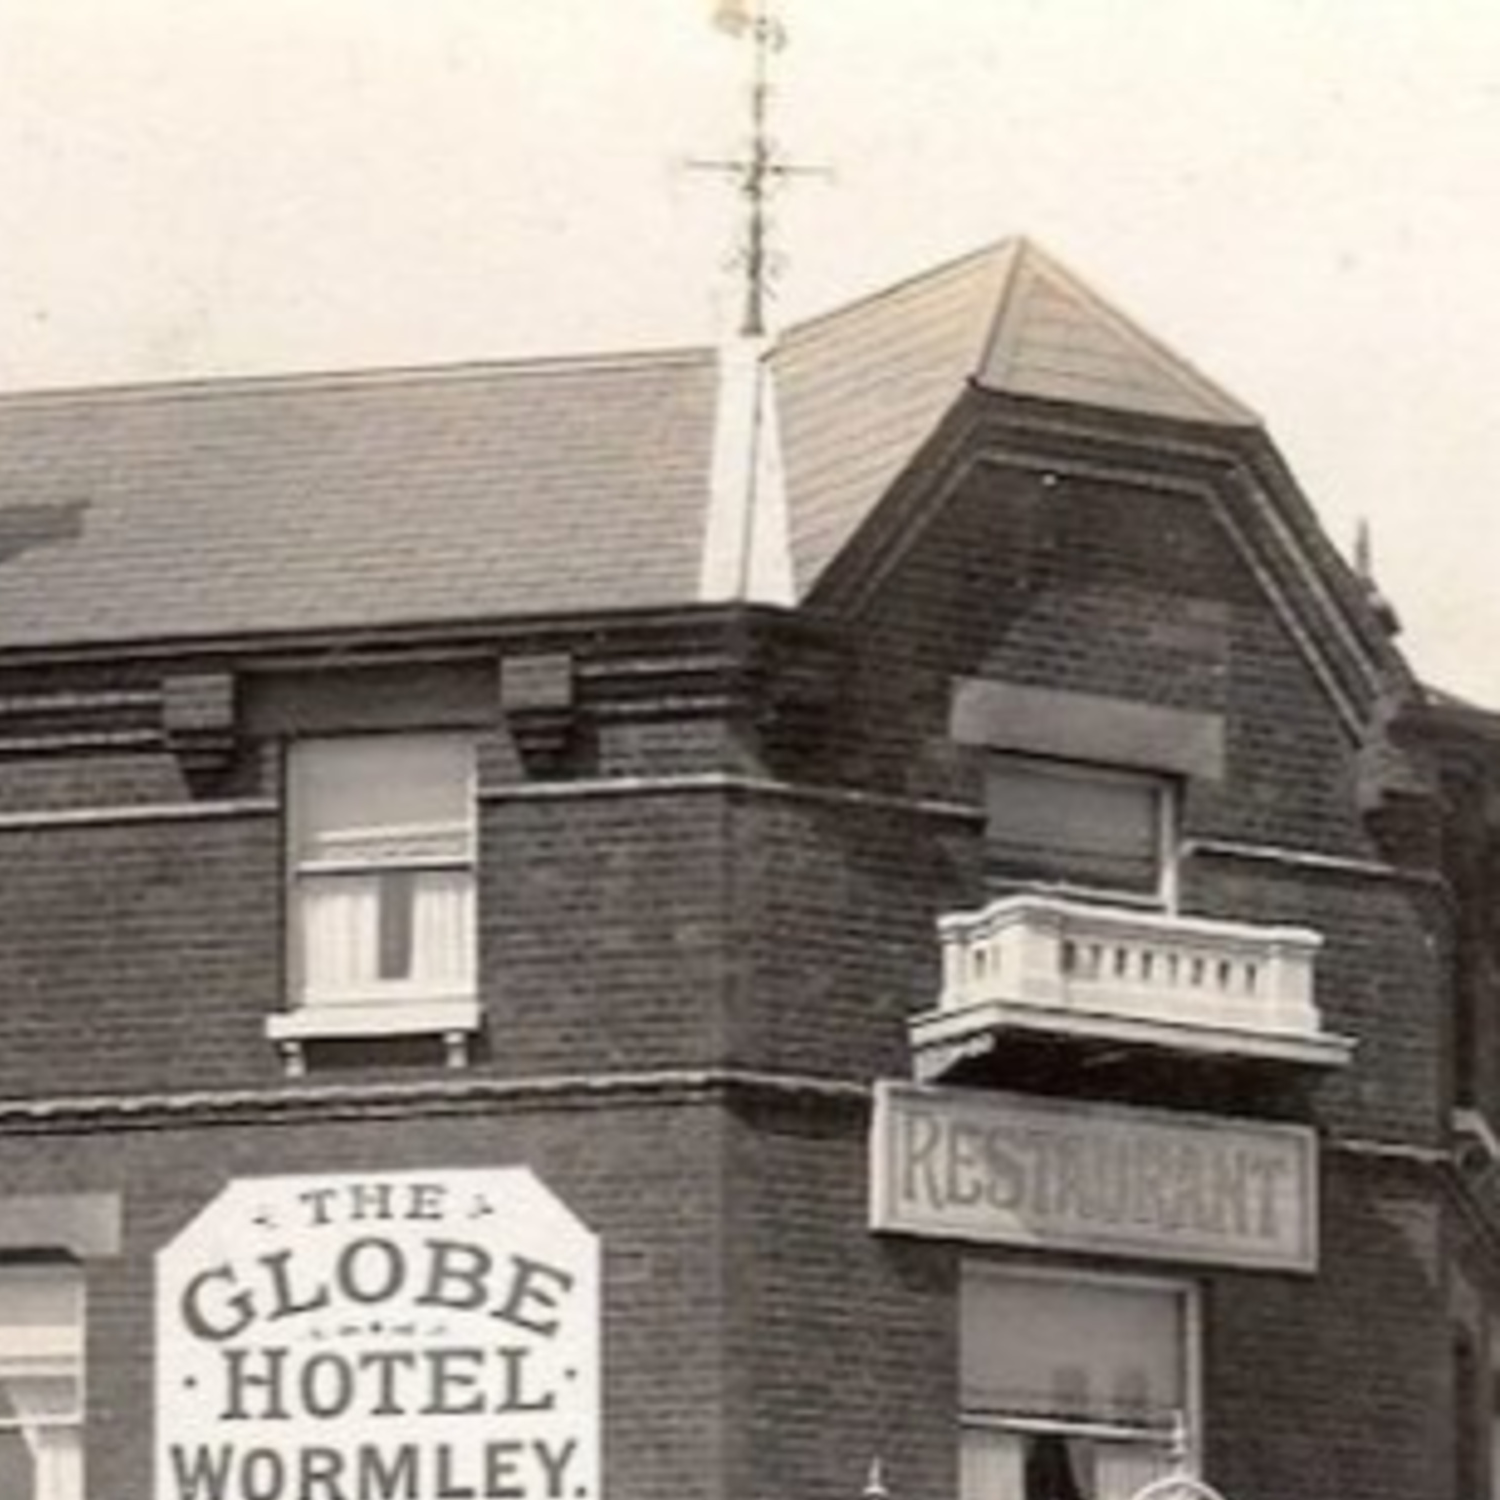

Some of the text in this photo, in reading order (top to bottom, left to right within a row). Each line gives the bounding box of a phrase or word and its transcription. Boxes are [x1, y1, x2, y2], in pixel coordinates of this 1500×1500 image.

[299, 1183, 447, 1224] THE
[180, 1237, 574, 1340] GLOBE
[218, 1347, 556, 1421] HOTEL
